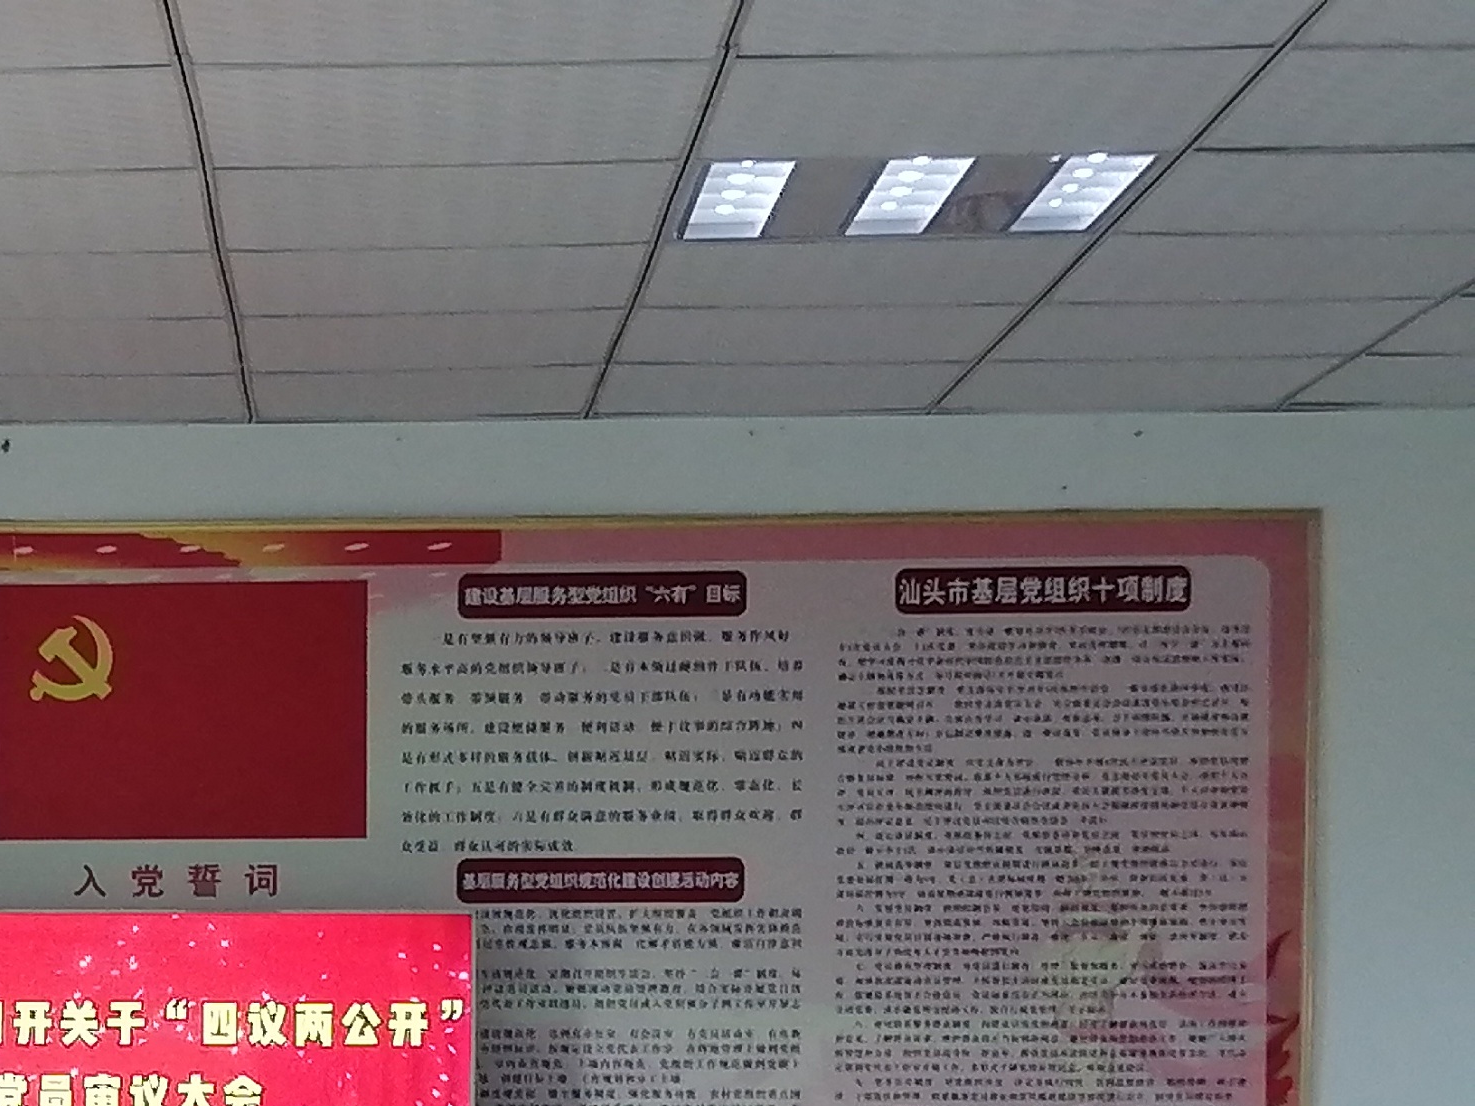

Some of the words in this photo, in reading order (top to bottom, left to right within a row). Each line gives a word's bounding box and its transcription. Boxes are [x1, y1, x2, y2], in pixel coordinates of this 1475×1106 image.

[899, 576, 1189, 606] 汕头市基层党组织十项制度
[73, 863, 280, 898] 入党誓词
